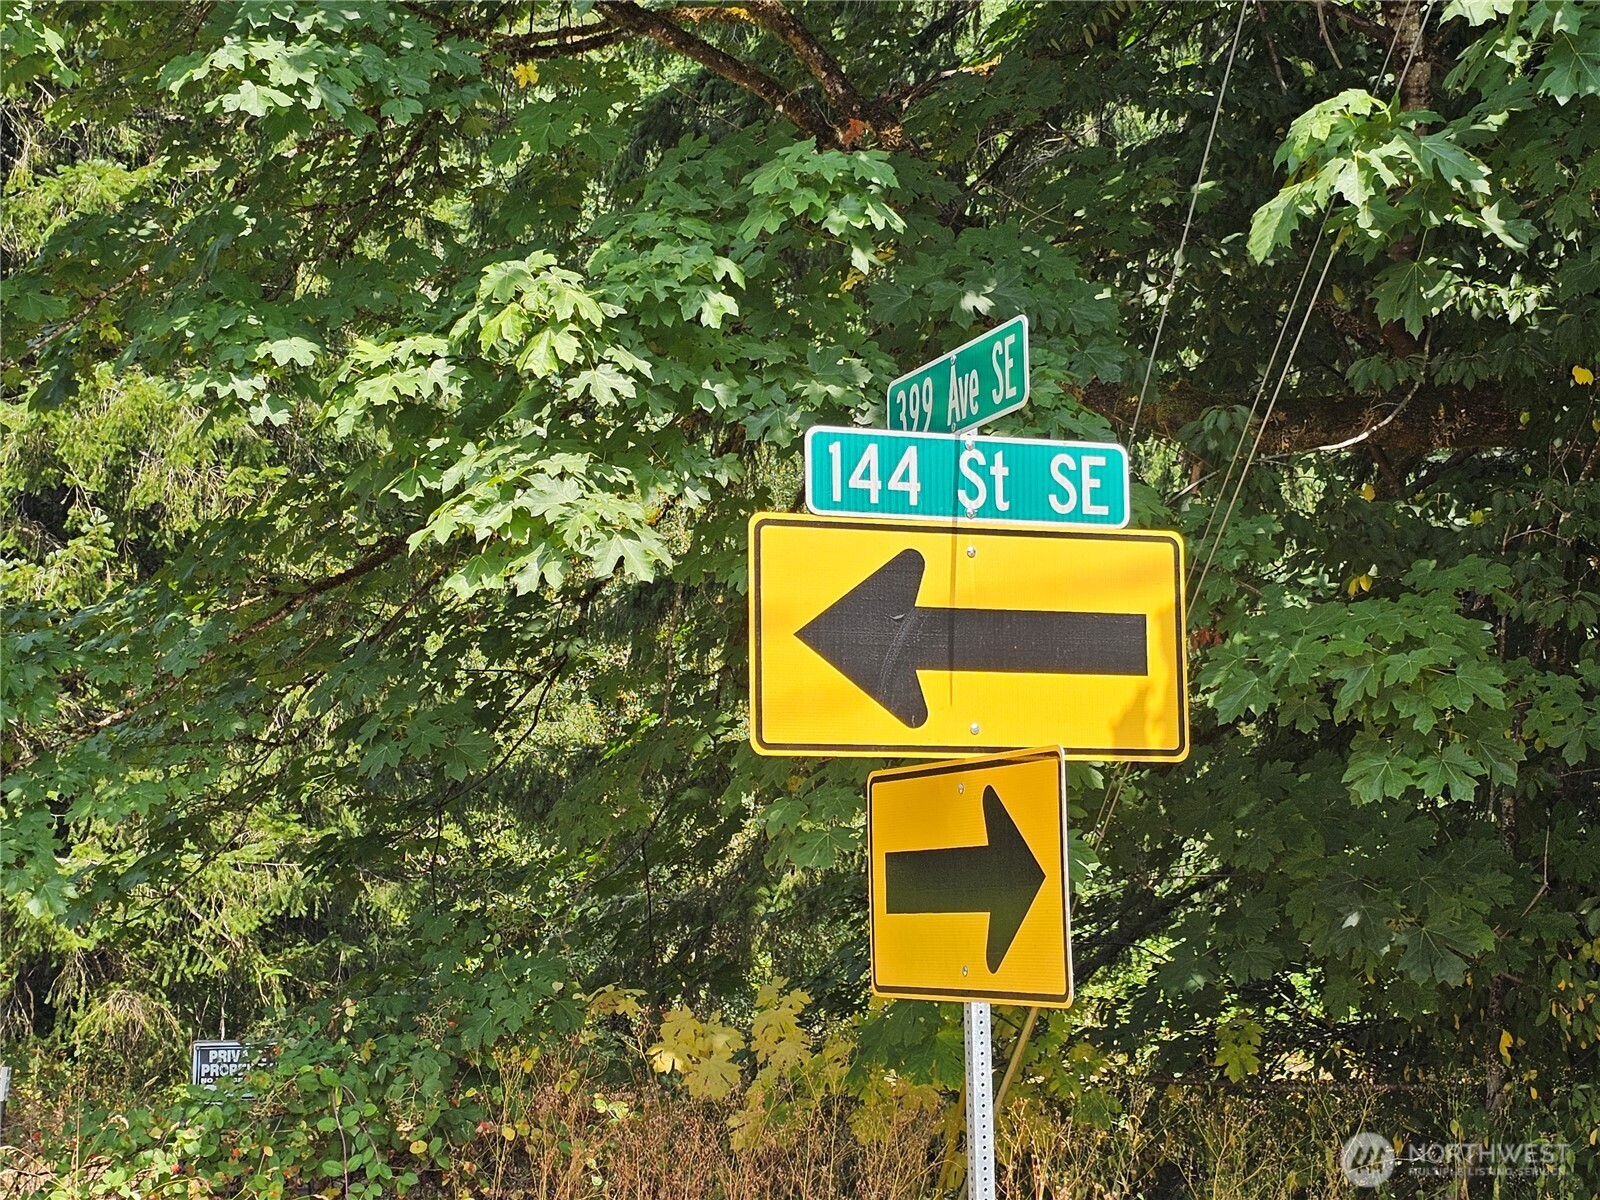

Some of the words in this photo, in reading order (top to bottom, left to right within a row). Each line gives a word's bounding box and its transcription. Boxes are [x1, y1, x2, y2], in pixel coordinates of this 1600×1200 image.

[896, 377, 933, 431] 399
[947, 365, 979, 426] Ave
[992, 333, 1017, 405] SE
[828, 441, 921, 506] 144
[958, 448, 1010, 512] St
[1048, 453, 1109, 516] SE
[201, 1063, 272, 1076] PROP
[209, 1050, 263, 1062] PRIV
